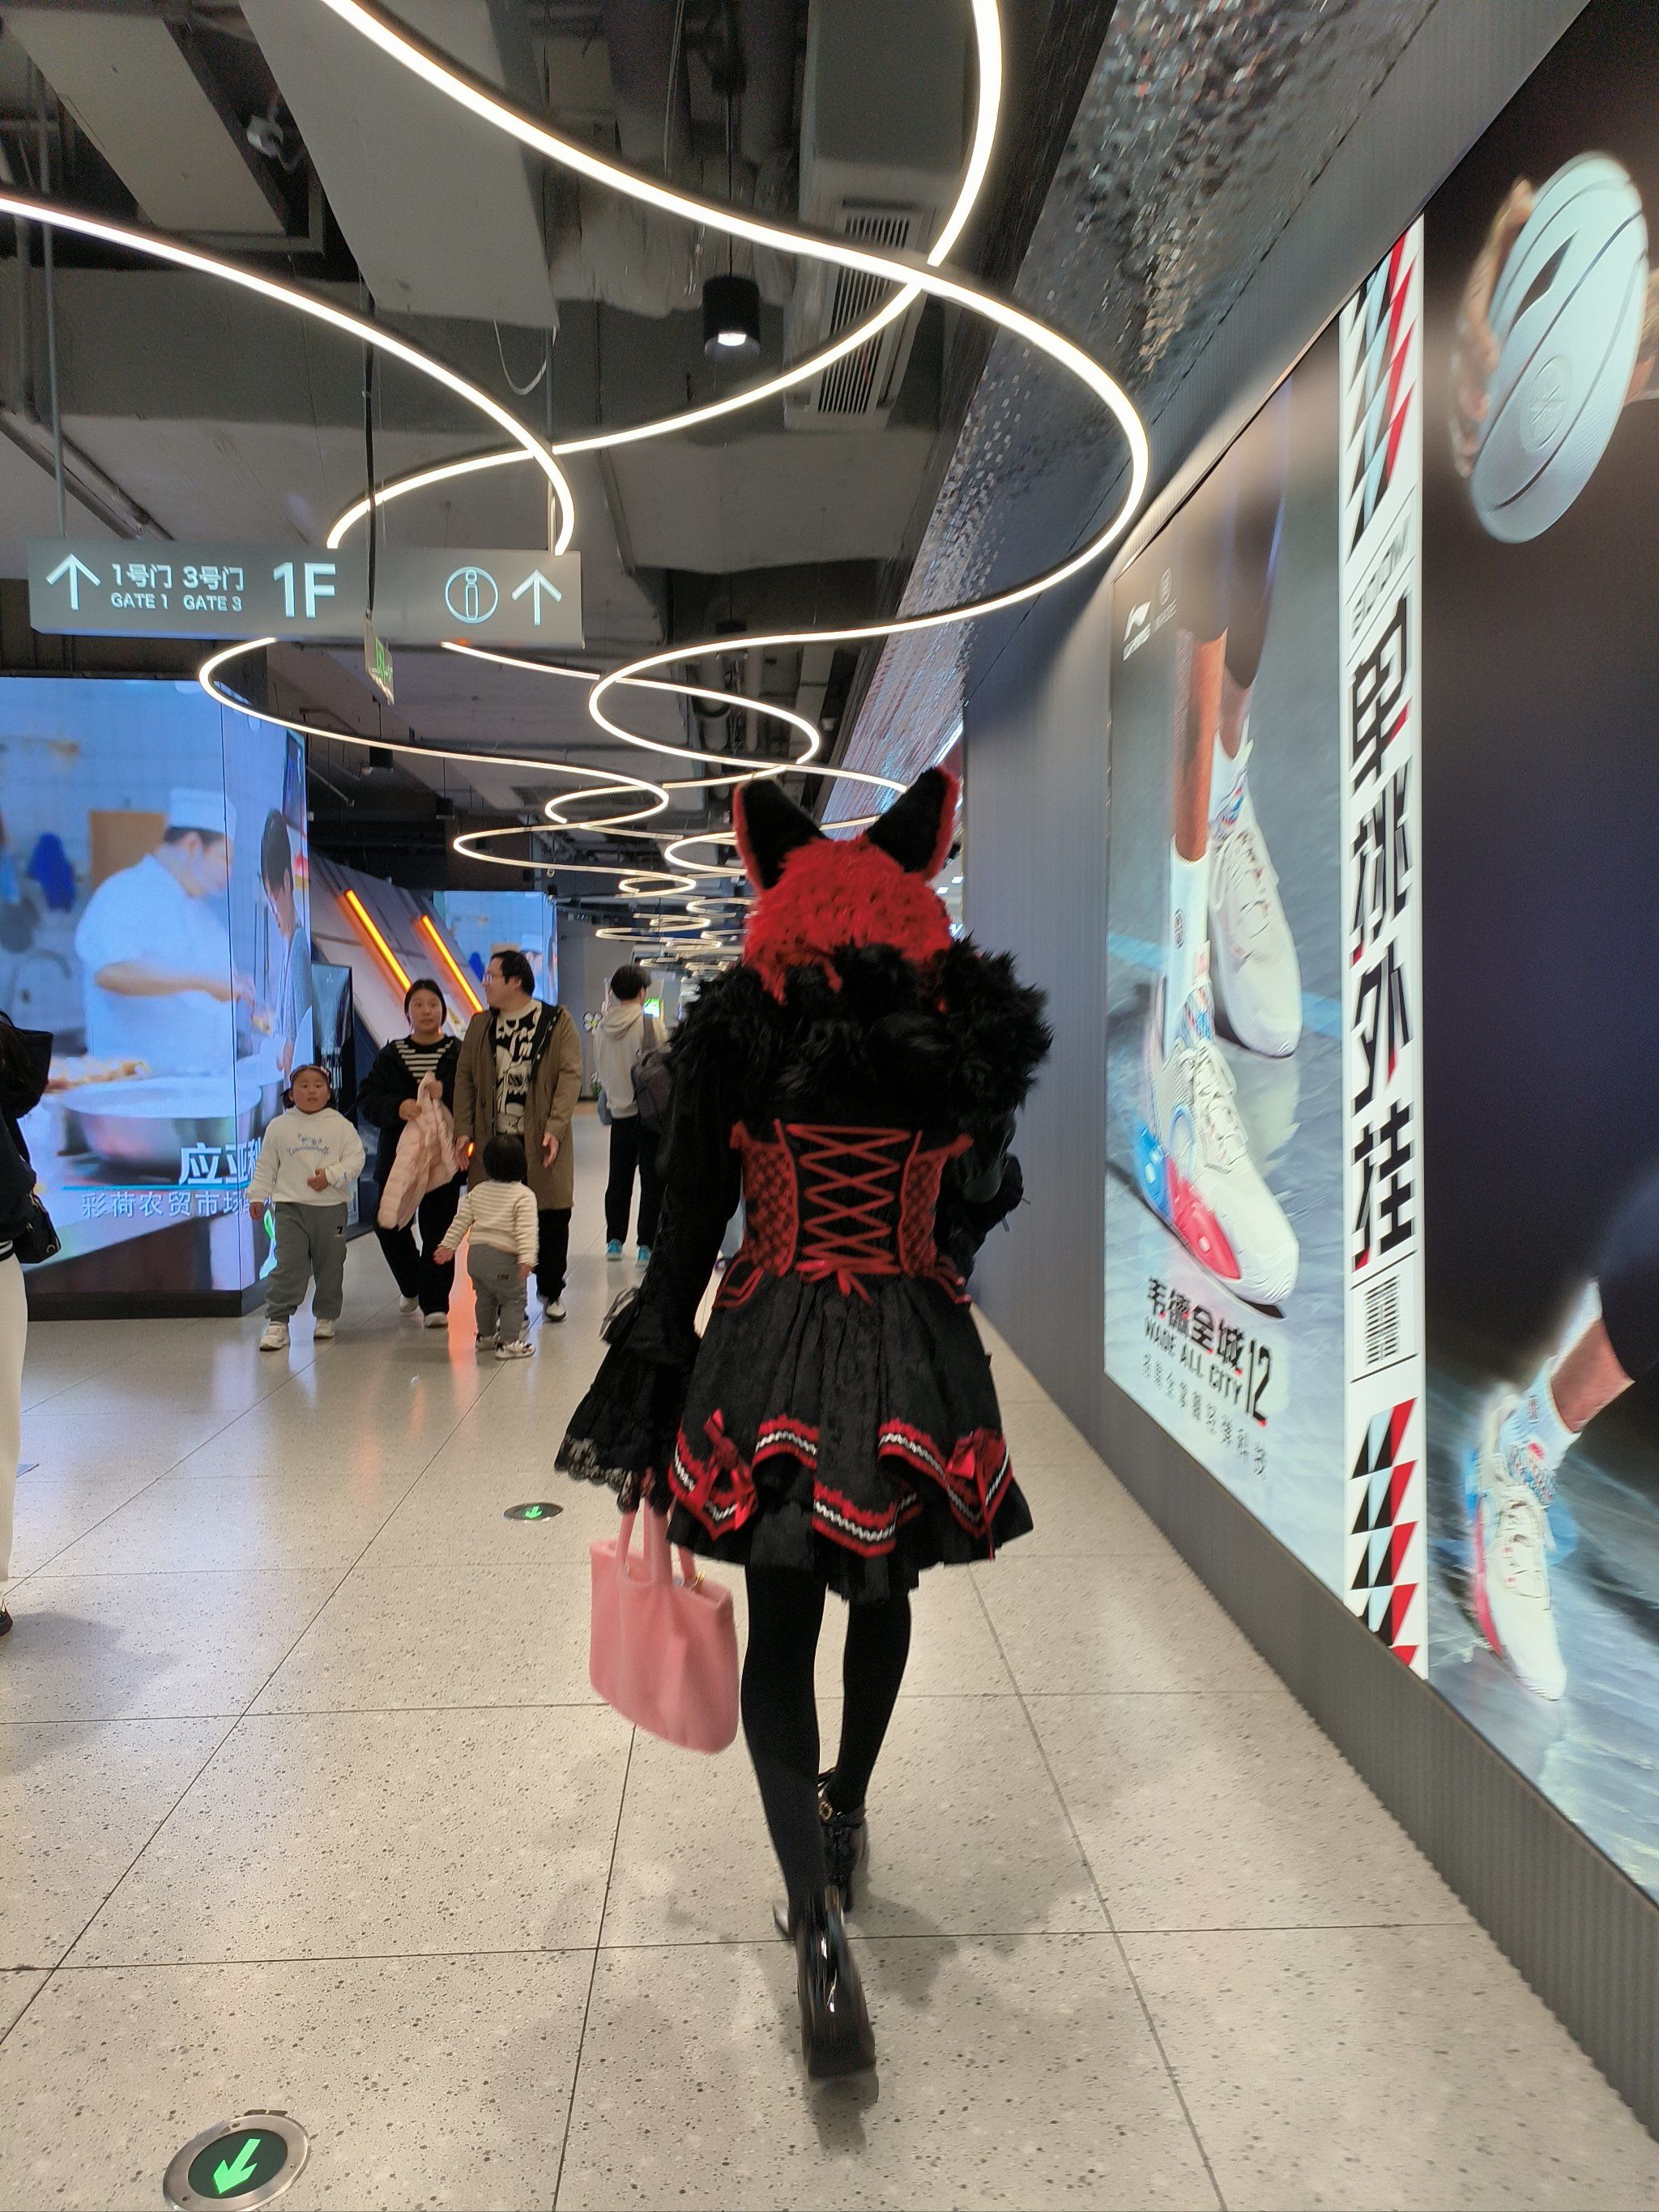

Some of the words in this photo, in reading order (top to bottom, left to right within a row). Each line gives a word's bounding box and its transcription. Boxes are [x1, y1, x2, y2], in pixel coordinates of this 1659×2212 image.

[112, 564, 173, 589] 1号门
[182, 565, 244, 590] 3号门
[273, 561, 335, 618] 1F
[110, 593, 156, 610] GATE
[161, 594, 168, 609] 1
[183, 595, 226, 612] GATE
[232, 595, 242, 612] 3
[1245, 1340, 1269, 1427] 12
